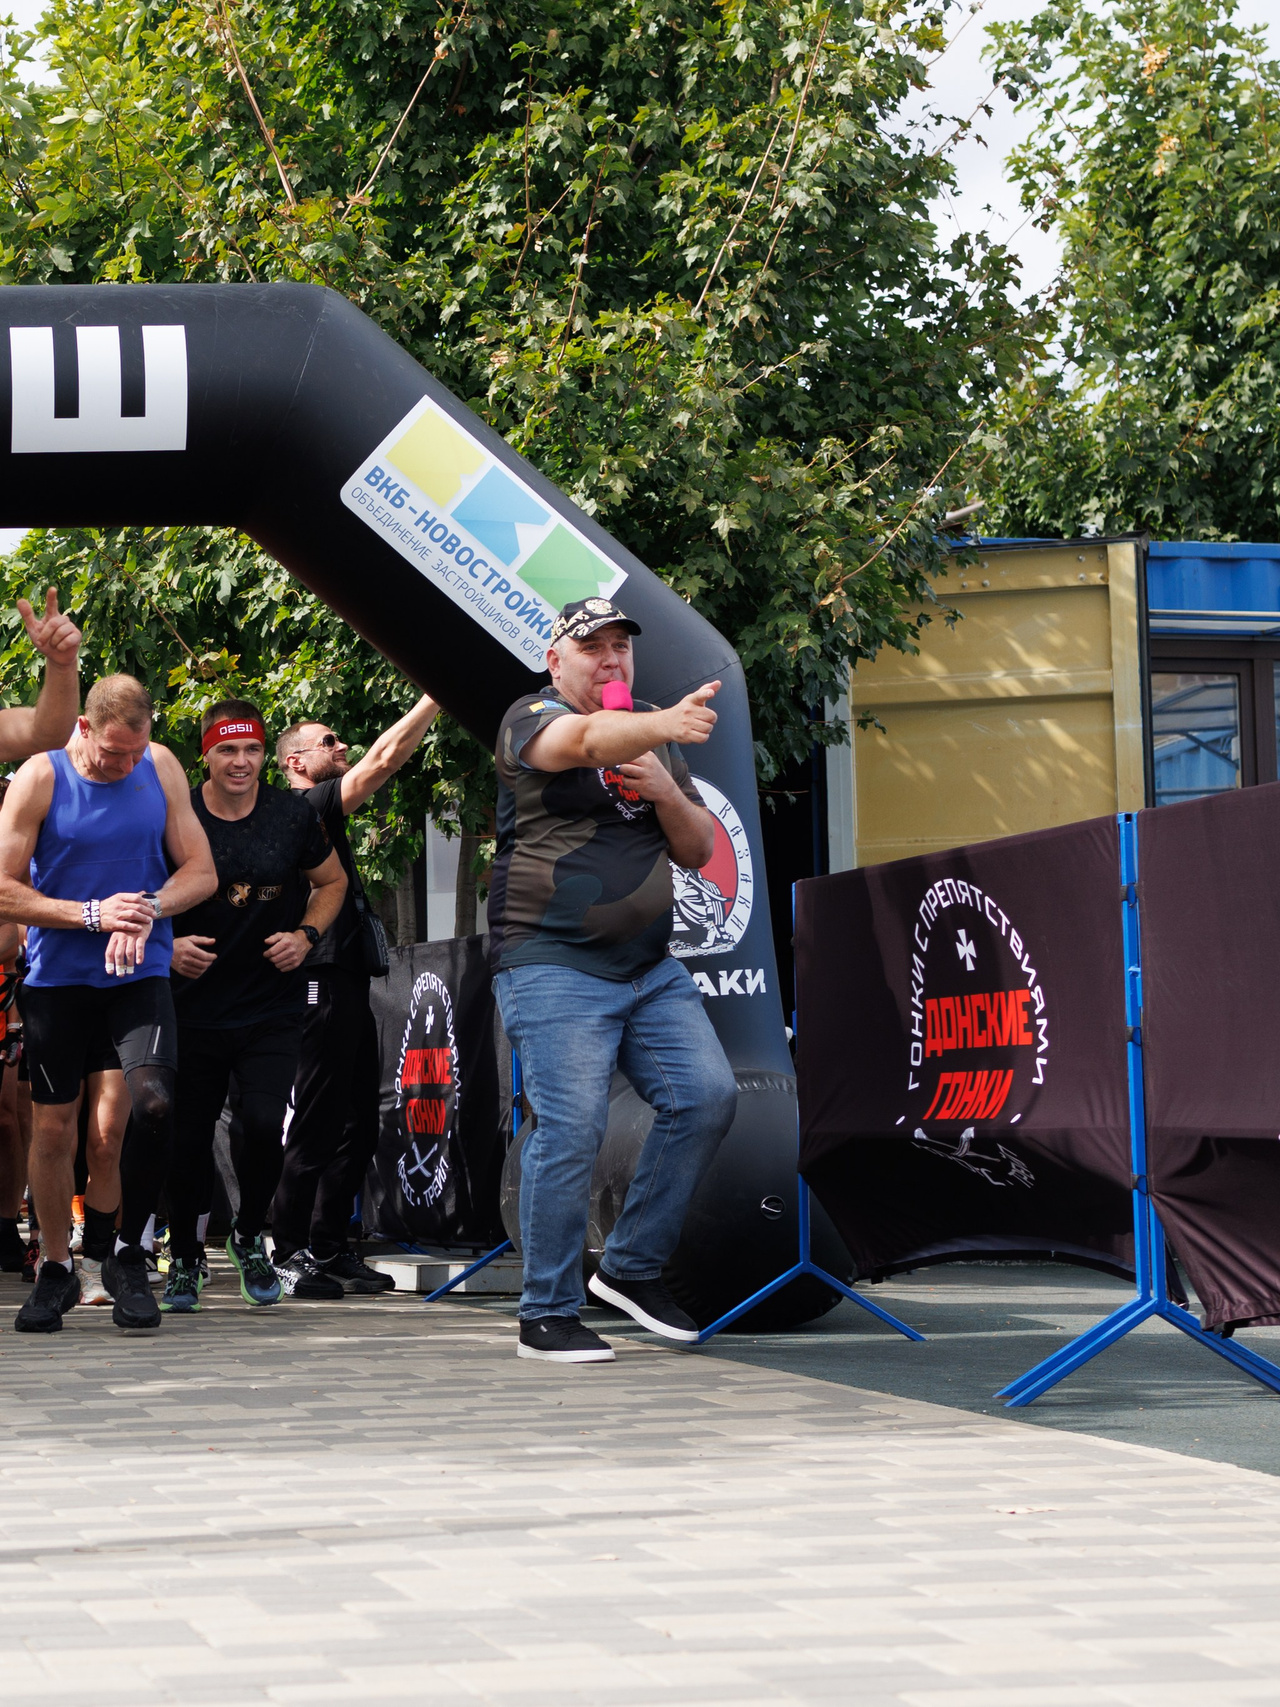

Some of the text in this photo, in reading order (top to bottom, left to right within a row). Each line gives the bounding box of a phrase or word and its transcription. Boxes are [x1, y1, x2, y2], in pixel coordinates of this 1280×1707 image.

[351, 487, 546, 662] ОБЪЕДИНЕНИЕ ЗАСТРОЙЩИКОВ ЮГА
[219, 723, 253, 736] 02511
[718, 802, 753, 932] КАЗАКИ
[692, 968, 767, 997] АКИ
[908, 953, 925, 1090] ГОНКИ
[919, 878, 1049, 1085] ПРЕПЯТСТВИЯМИ
[924, 988, 1033, 1058] ДОНСКИЕ
[401, 1047, 452, 1090] ДОНСКИЕ
[922, 1068, 1014, 1120] ГОНКИ
[405, 1098, 447, 1135] ГОНКИ
